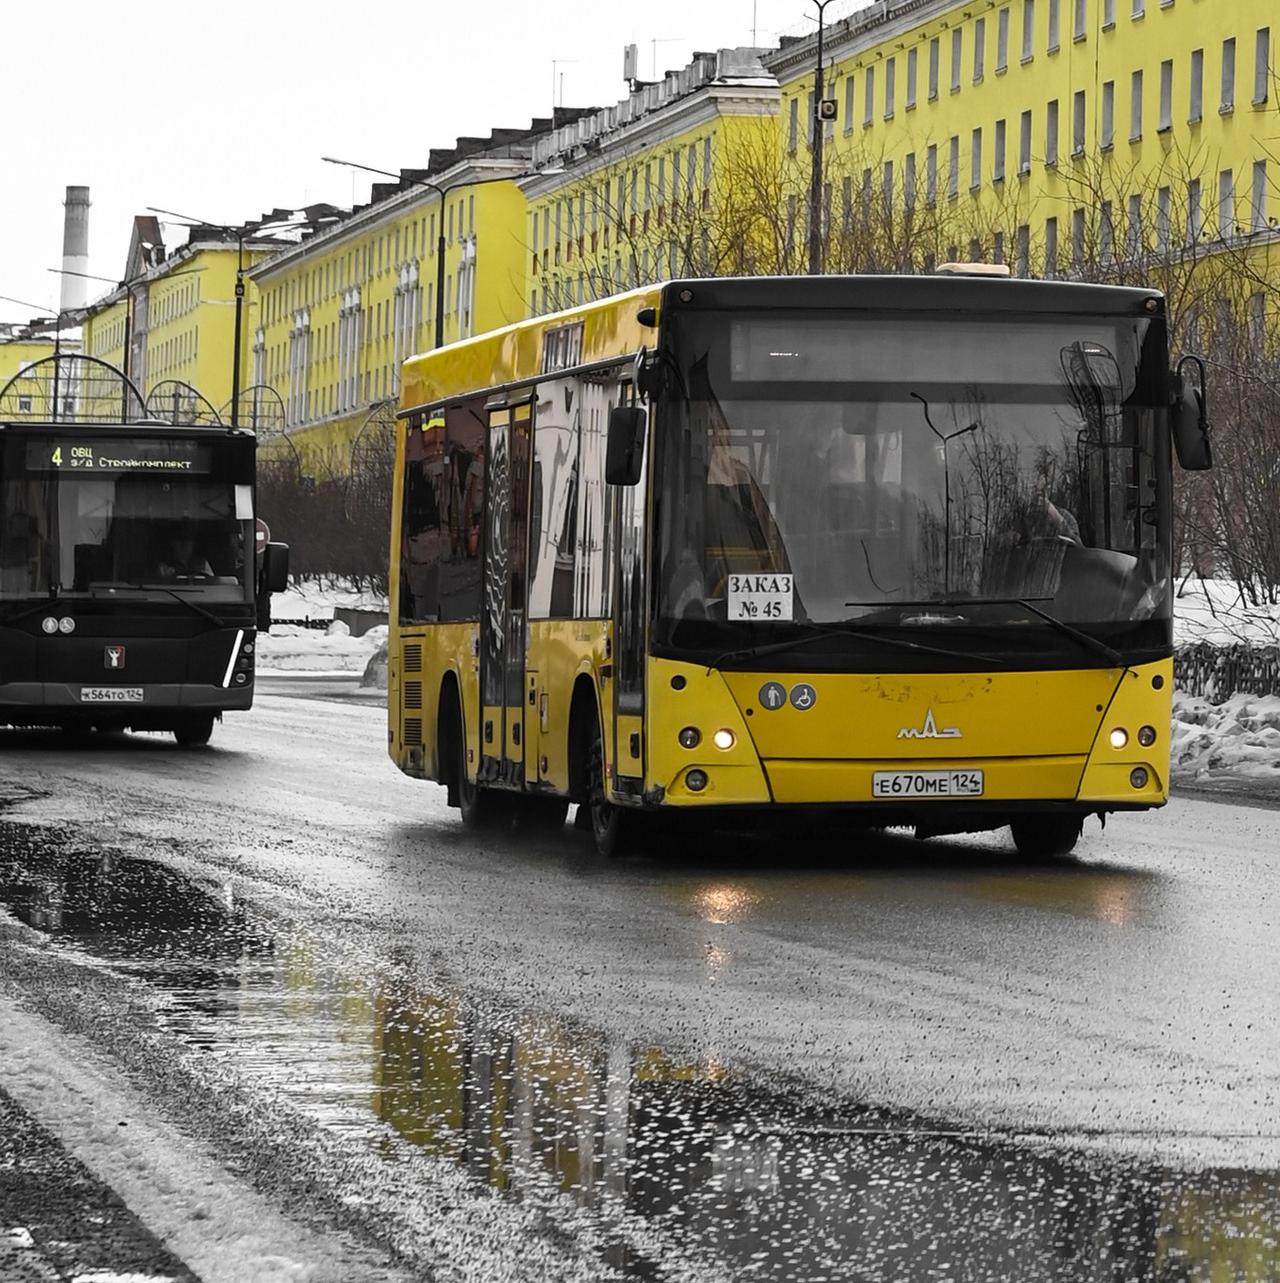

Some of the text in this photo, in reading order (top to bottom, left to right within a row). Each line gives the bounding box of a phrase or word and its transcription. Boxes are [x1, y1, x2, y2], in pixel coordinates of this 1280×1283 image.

[52, 447, 63, 466] 4
[730, 576, 791, 594] ЗАКАЗ
[739, 601, 782, 618] № 45
[880, 775, 948, 794] Е670МЕ
[952, 774, 980, 788] 124
